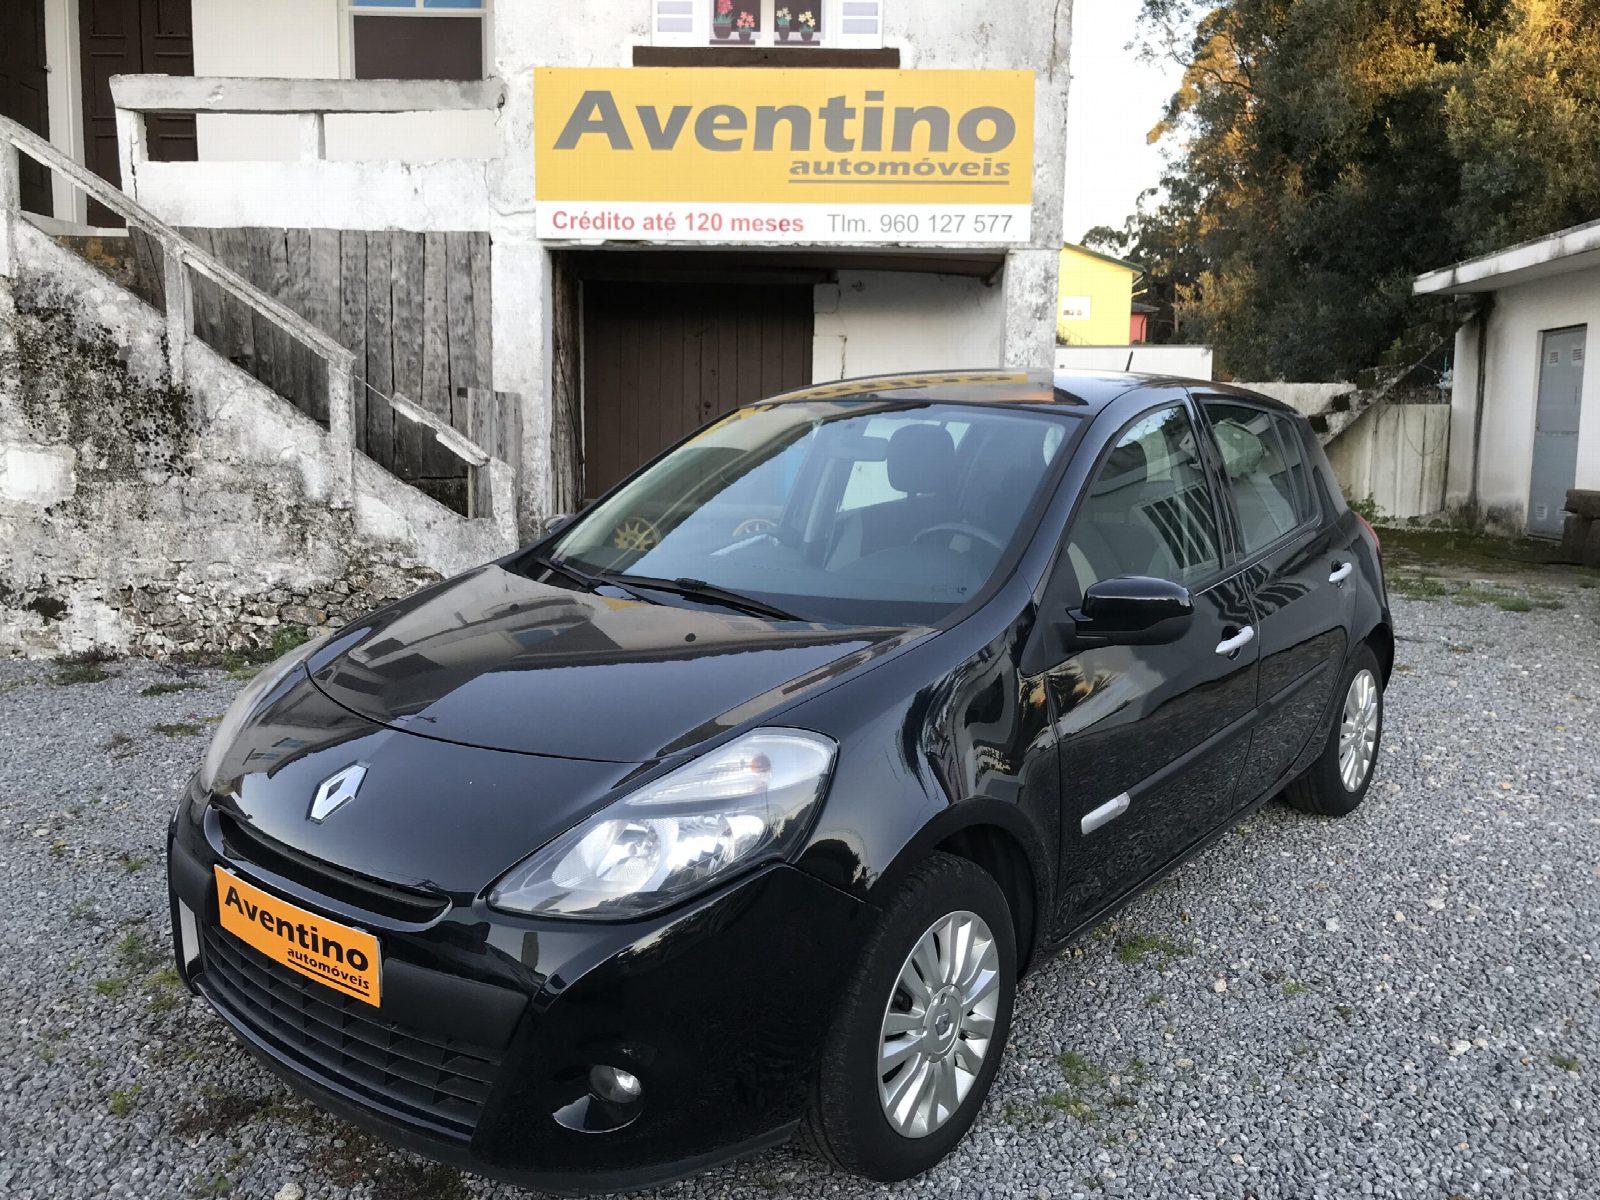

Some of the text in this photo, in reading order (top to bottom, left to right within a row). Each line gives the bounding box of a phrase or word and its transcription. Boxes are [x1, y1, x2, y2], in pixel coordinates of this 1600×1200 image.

[552, 90, 1016, 153] Aventino
[789, 157, 1010, 177] automóveis
[552, 211, 804, 232] Crédito até 120 meses
[828, 214, 1013, 233] Tlm. 960 127 577
[225, 886, 369, 972] Aventino
[287, 948, 370, 990] automóveis
